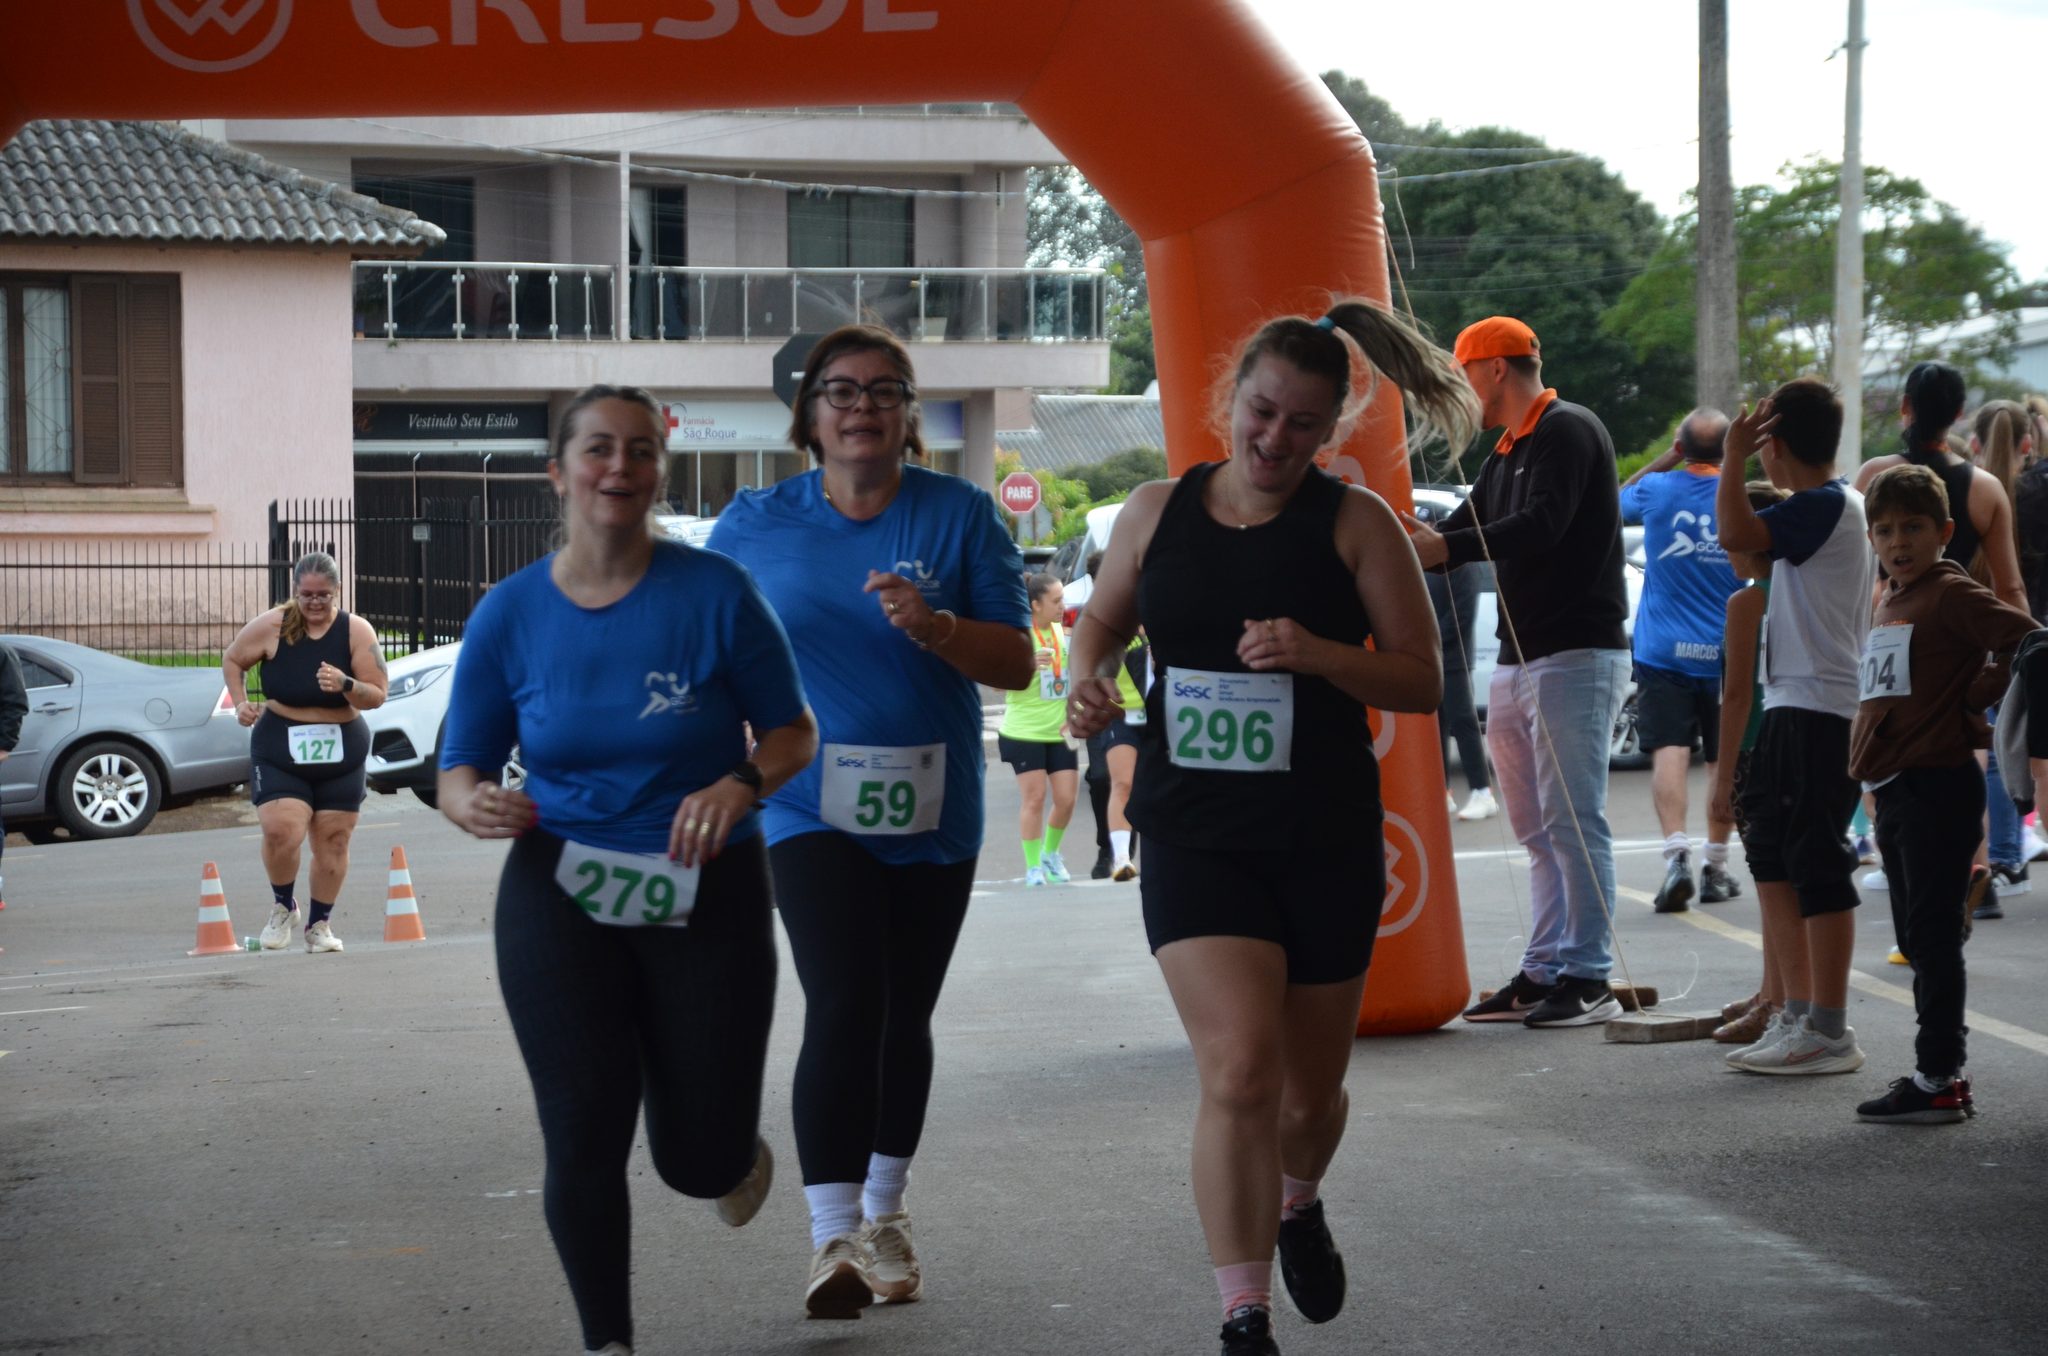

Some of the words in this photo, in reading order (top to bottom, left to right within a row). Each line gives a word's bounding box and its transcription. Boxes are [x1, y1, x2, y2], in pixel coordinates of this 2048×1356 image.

[408, 413, 457, 429] Vestindo
[461, 413, 482, 428] Seu
[486, 412, 519, 428] Estilo
[683, 415, 715, 426] Farmácia
[683, 427, 702, 439] São
[705, 427, 737, 440] Roque
[1007, 486, 1033, 499] PARE
[1675, 641, 1720, 661] MARCOS
[1177, 706, 1274, 763] 296
[297, 739, 336, 760] 127
[855, 780, 916, 827] 59
[574, 860, 676, 922] 279
